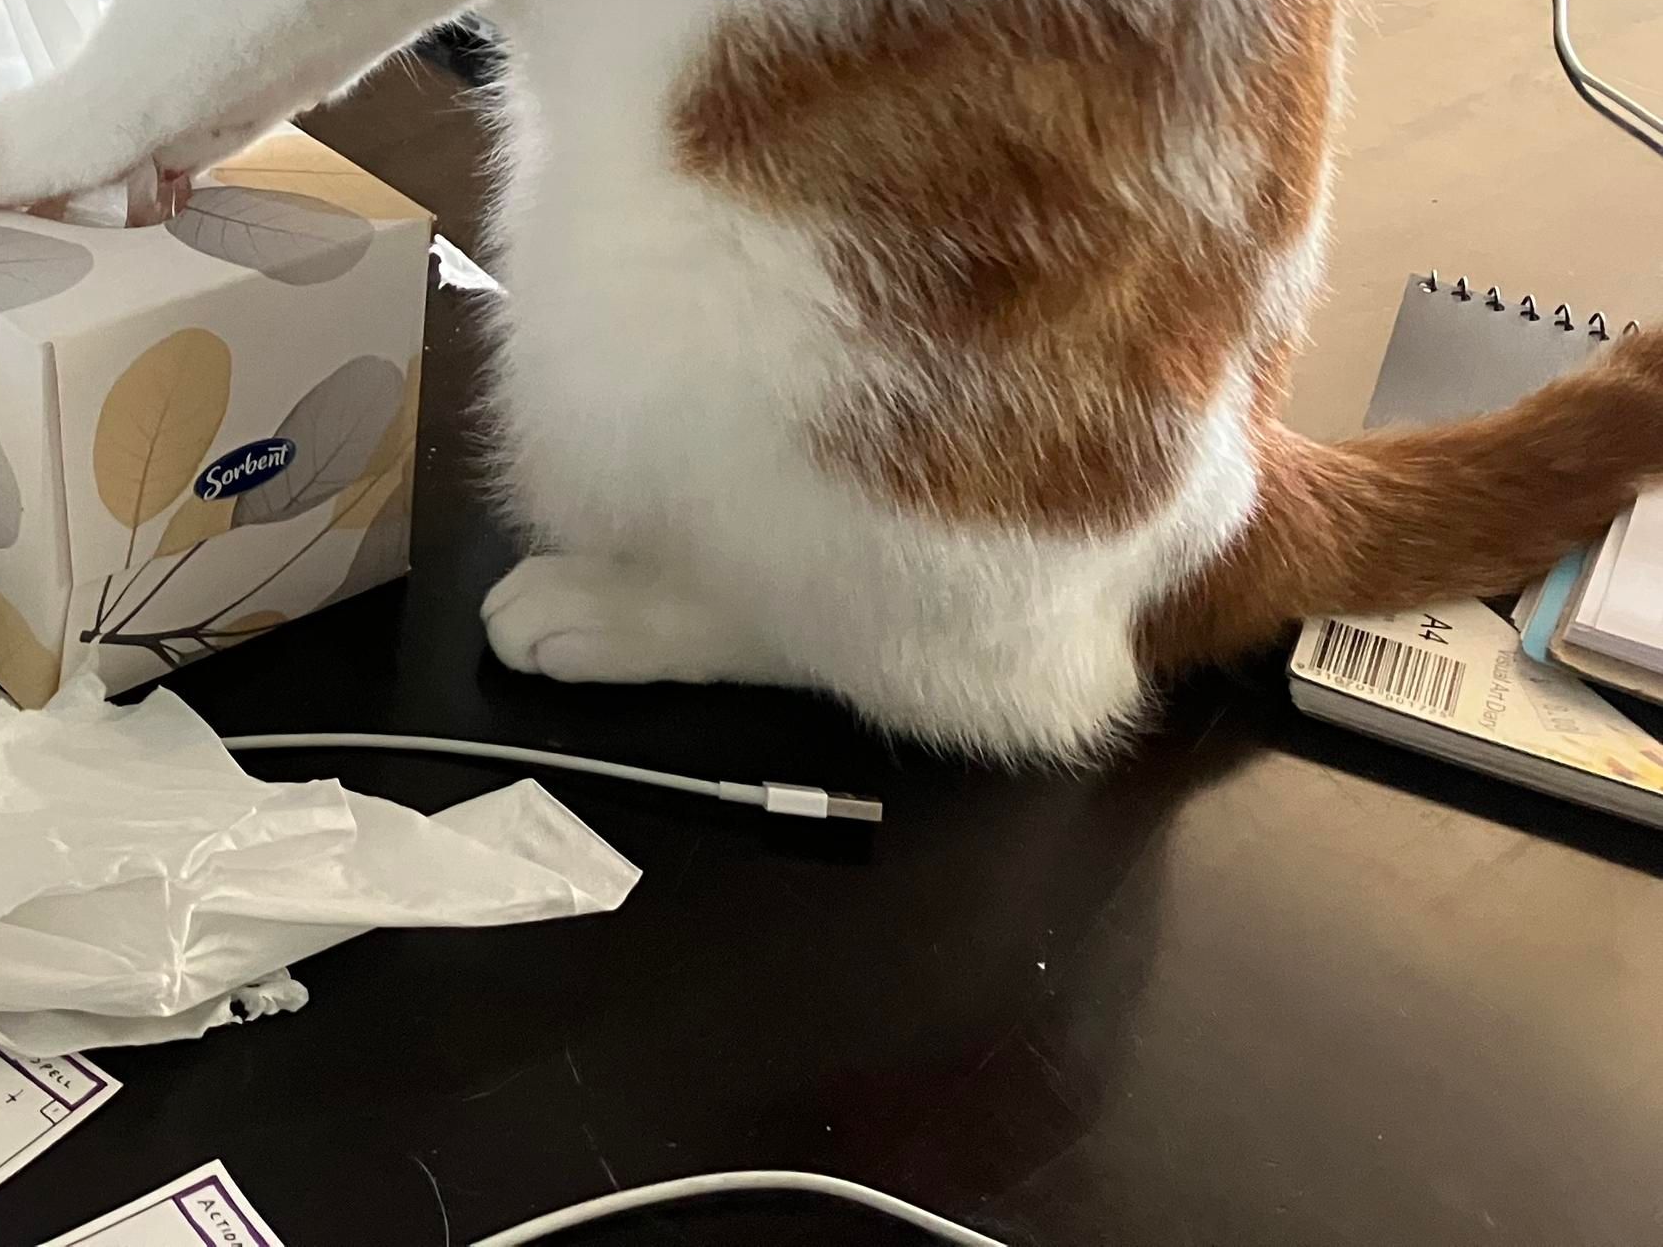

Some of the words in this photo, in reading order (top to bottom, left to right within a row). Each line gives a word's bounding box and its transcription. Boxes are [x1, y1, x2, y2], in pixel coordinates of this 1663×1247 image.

[203, 444, 289, 501] Sorbent
[1418, 613, 1453, 645] A4
[1493, 650, 1517, 684] Visual
[1490, 681, 1510, 701] Art
[1478, 700, 1506, 731] Diary
